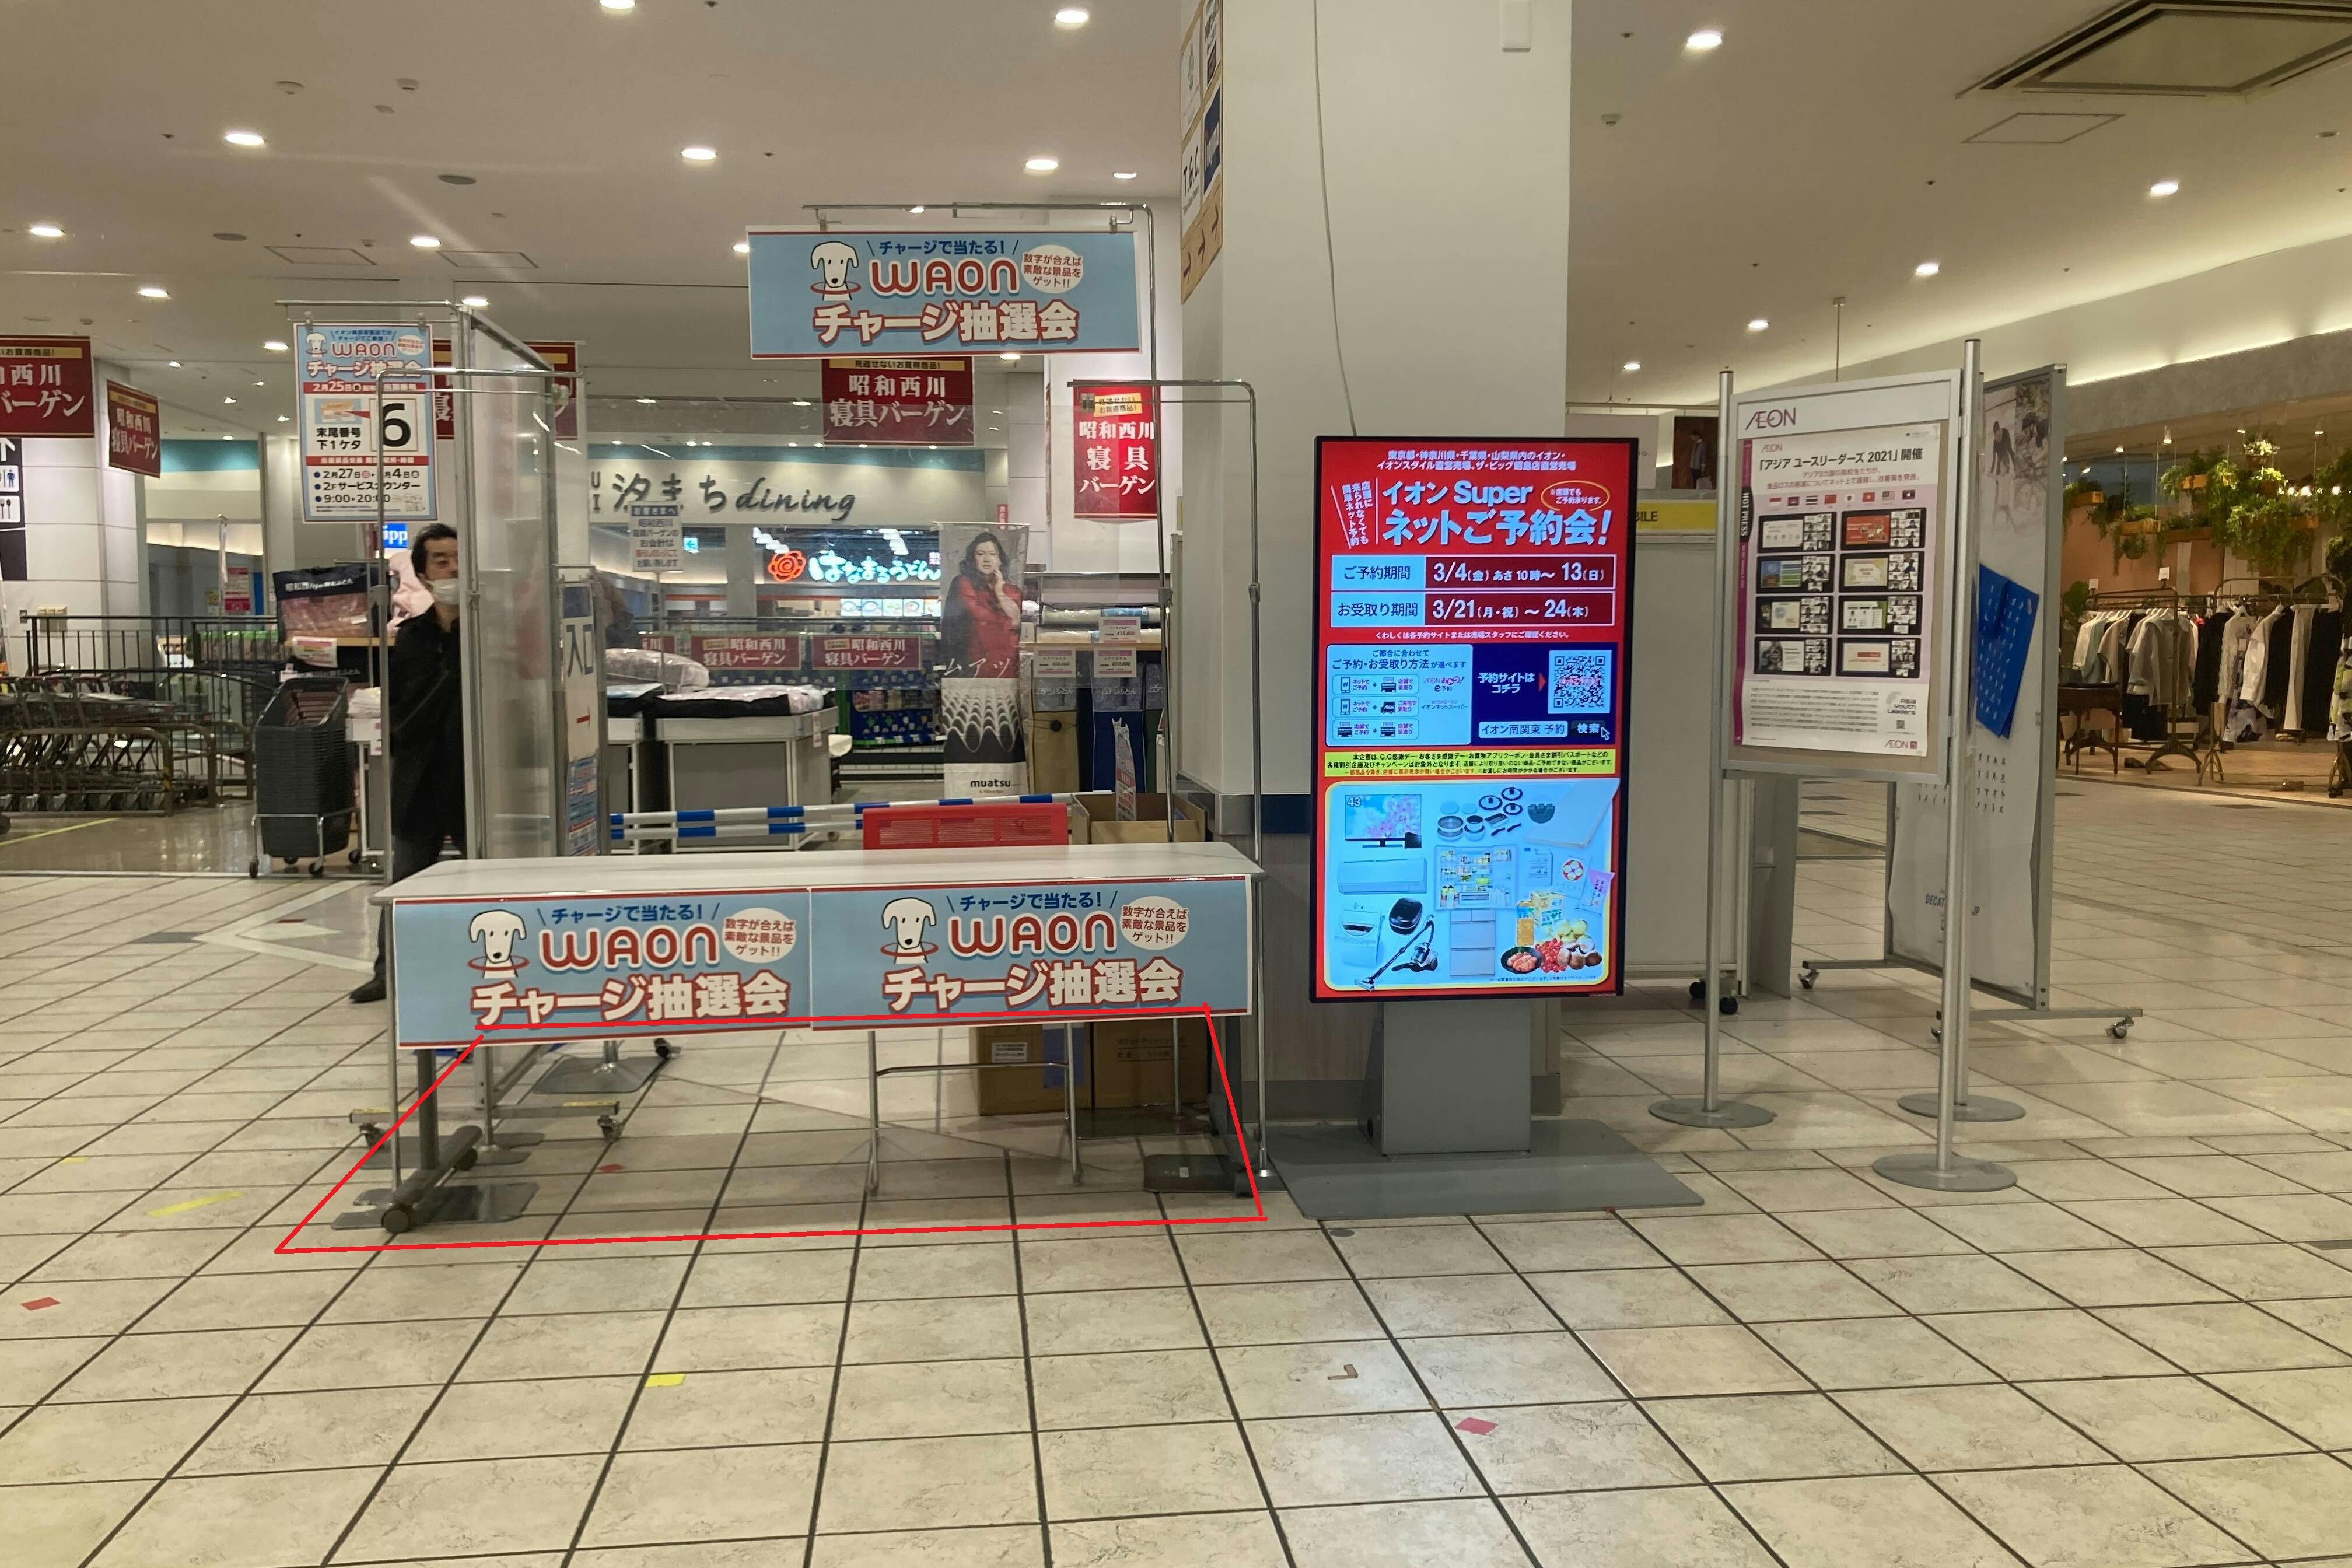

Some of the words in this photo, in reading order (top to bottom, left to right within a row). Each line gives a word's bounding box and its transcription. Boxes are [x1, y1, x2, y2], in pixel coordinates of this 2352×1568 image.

[879, 240, 1005, 255] チャージで当たる!
[1024, 253, 1082, 266] 数字が合えば
[870, 258, 1020, 295] WAON
[1023, 265, 1082, 278] 素敵な景品を
[1032, 277, 1071, 288] ゲット!!
[814, 301, 1079, 343] チャージ抽選会
[332, 343, 396, 356] WAON
[849, 374, 946, 398] 昭和西川
[830, 399, 965, 428] 寝具バーゲン
[317, 427, 362, 438] 末尾番号
[383, 402, 411, 447] 6
[1079, 421, 1155, 440] 昭和西川
[317, 440, 361, 450] 下1ケタ
[1794, 452, 1864, 468] ユースリーダーズ
[1901, 448, 1923, 461] 開催
[1079, 477, 1156, 496] バーゲン
[1382, 480, 1449, 505] イオン
[1454, 480, 1534, 506] Super
[736, 477, 856, 520] dining
[1742, 492, 1751, 509] HOT
[1382, 508, 1612, 546] ネットご予約会!
[1740, 510, 1749, 537] PRESS
[808, 550, 942, 584] はなまるうどん
[1343, 565, 1410, 581] ご予約期間
[1433, 562, 1490, 583] 3/4(金)
[1493, 570, 1513, 582] あさ
[1338, 601, 1419, 618] お受取り期間
[1544, 598, 1589, 618] 24(木)
[730, 638, 786, 651] 昭和西川
[852, 638, 905, 652] 昭和西川
[1372, 649, 1429, 657] ご都合に合わせて
[703, 652, 786, 666] 寝具バーゲン
[825, 652, 907, 666] 寝具バーゲン
[944, 657, 1011, 678] ムアツ
[1478, 673, 1535, 683] 予約サイトは
[1492, 684, 1521, 694] コチラ
[1482, 724, 1541, 735] イオン南関東
[1544, 724, 1565, 734] 予約
[1347, 797, 1362, 807] 43
[961, 892, 1102, 911] チャージで当たる!
[551, 904, 704, 925] チャージで当たる!
[1122, 907, 1188, 920] 数字が合えば
[724, 917, 795, 932] 数字が合えば
[1121, 919, 1187, 933] 素敵な景品を
[724, 930, 794, 945] 素敵な景品を
[949, 913, 1118, 956] WAON
[1132, 932, 1175, 944] ゲット!!
[541, 926, 718, 970] WAON
[736, 944, 781, 958] ゲット!!
[882, 957, 1184, 1013] チャージ抽選会
[471, 970, 790, 1026] チャージ抽選会
